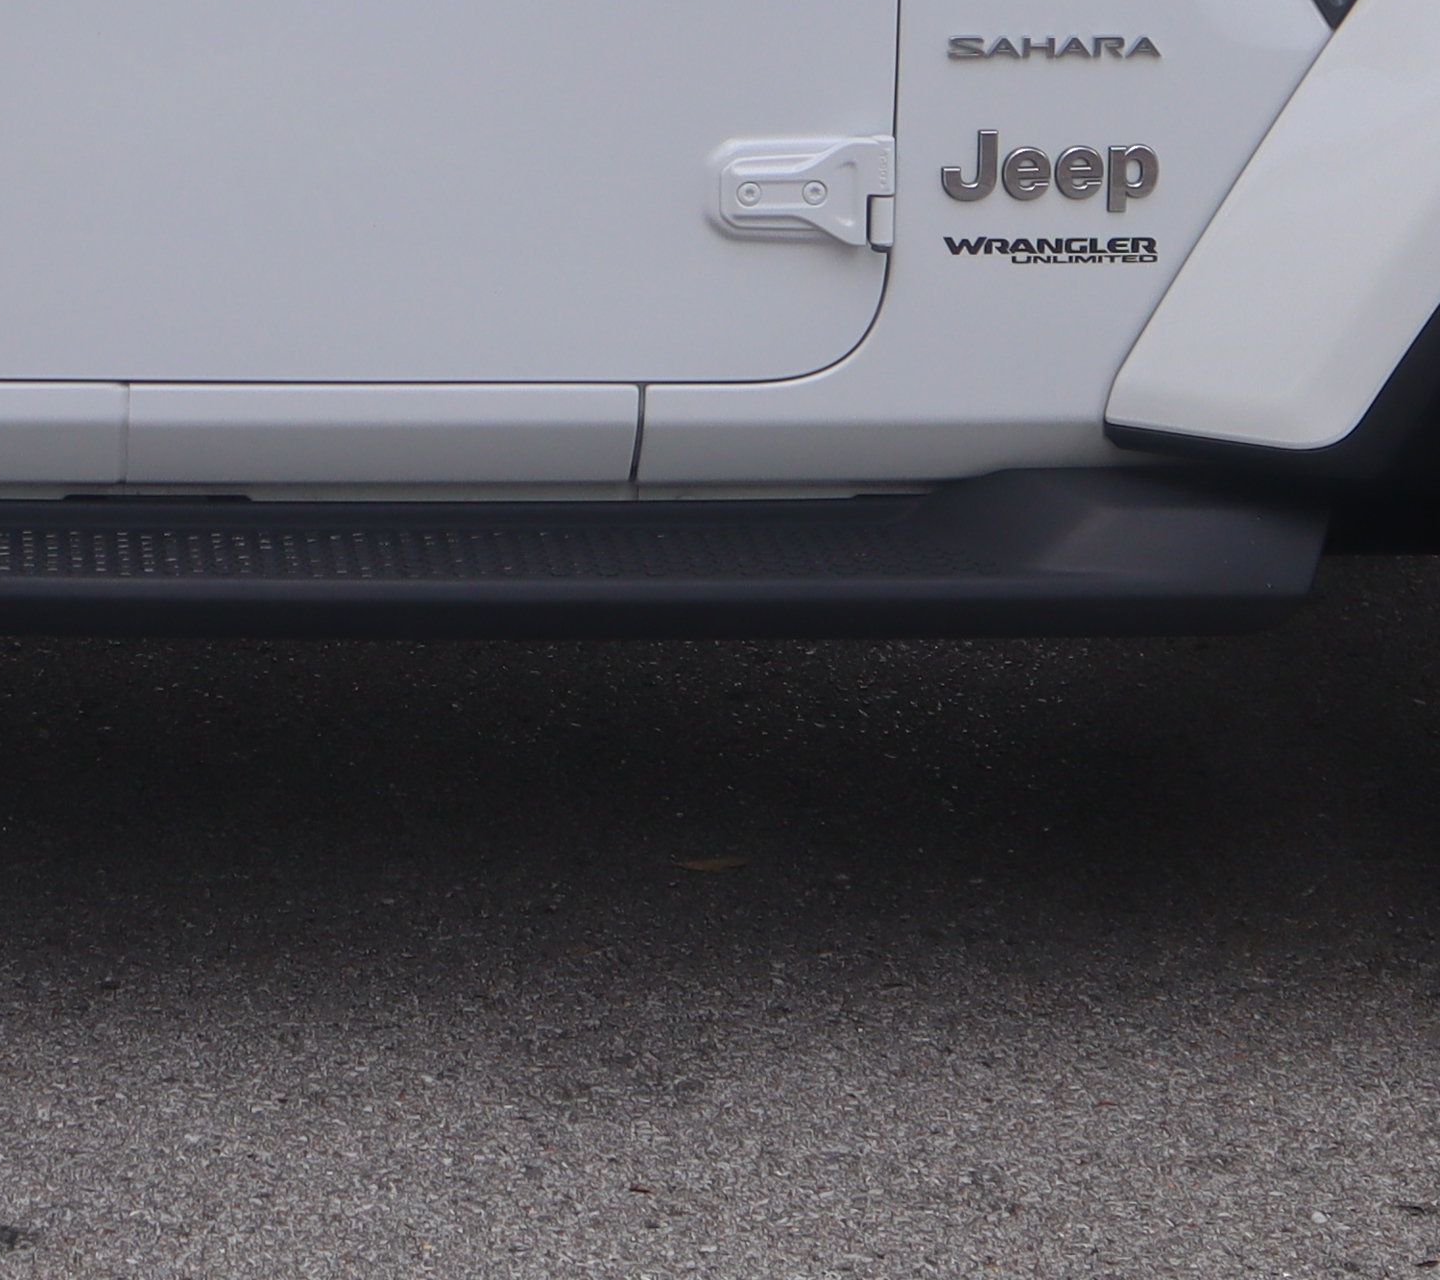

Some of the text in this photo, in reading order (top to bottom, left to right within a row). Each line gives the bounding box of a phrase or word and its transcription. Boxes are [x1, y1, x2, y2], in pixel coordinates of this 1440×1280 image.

[946, 36, 1161, 59] SAHARA
[940, 129, 1159, 213] Jeep
[943, 236, 1158, 255] WRANGLER
[1010, 254, 1159, 265] UNLIMITED
